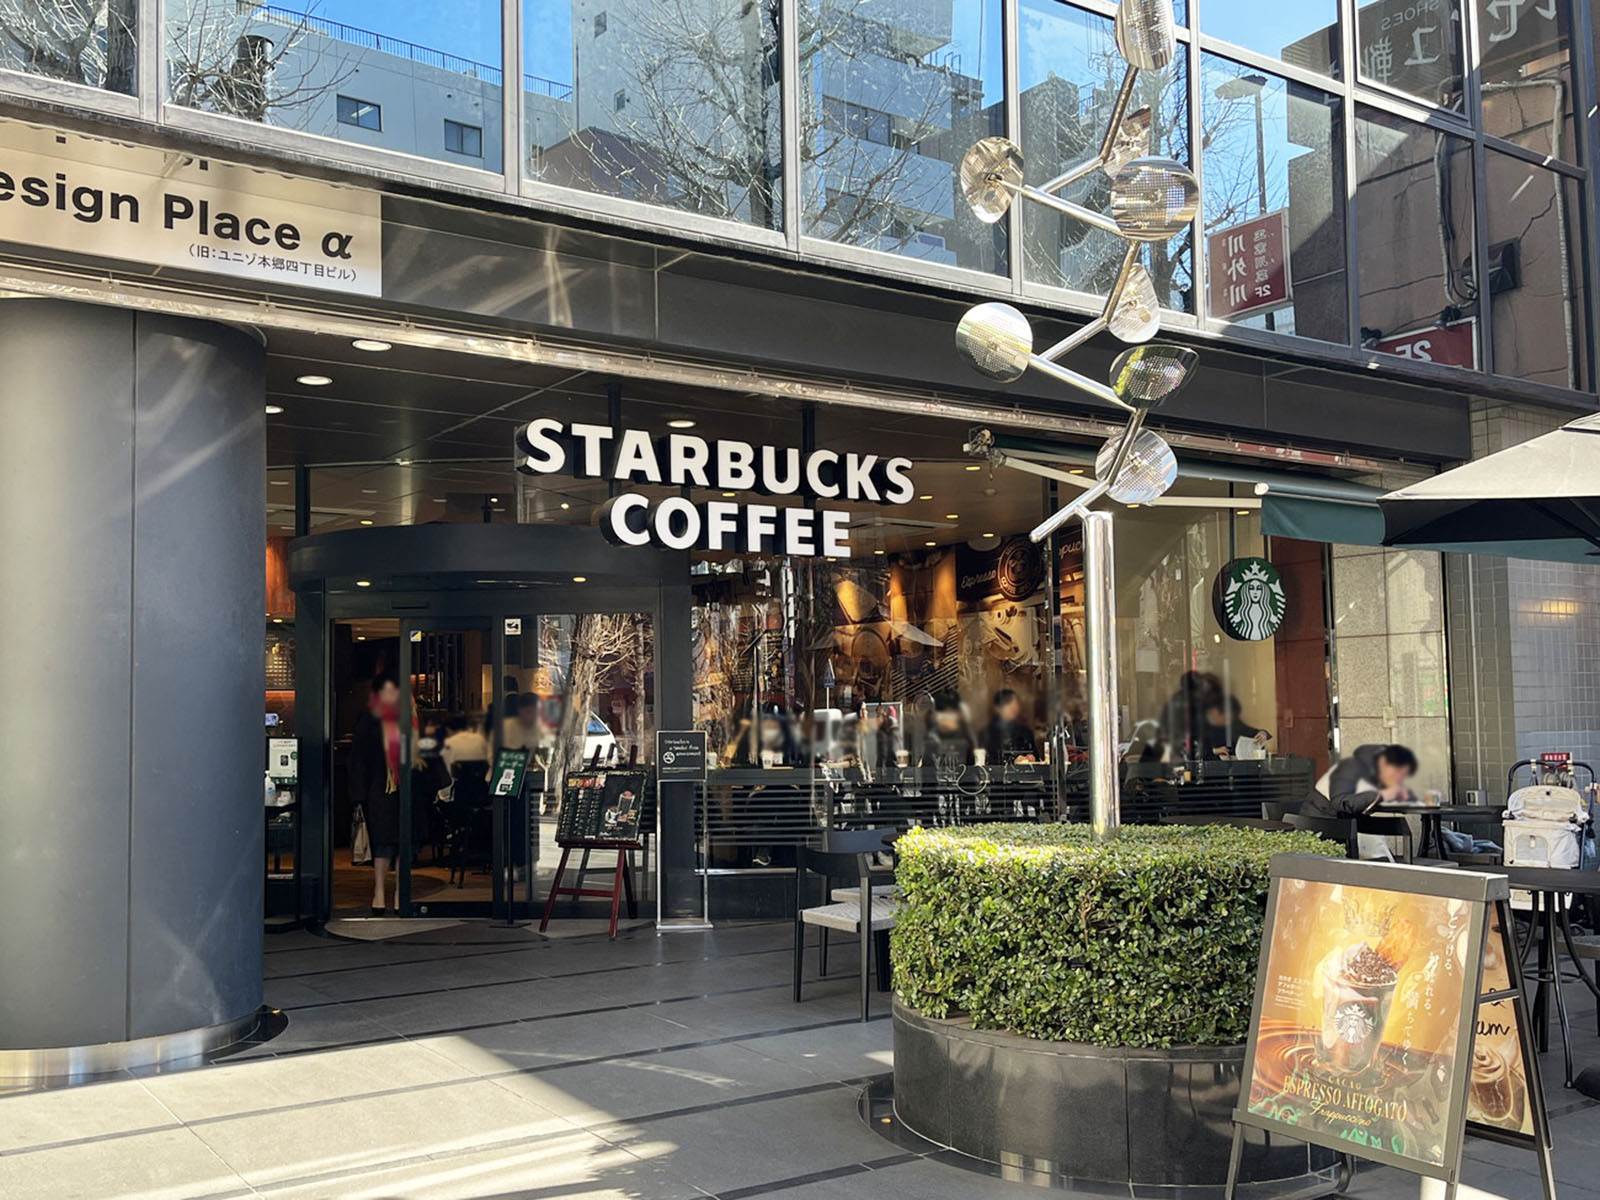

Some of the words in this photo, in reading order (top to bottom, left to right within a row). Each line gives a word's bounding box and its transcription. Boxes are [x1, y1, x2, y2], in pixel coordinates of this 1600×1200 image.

[164, 194, 301, 250] Place
[523, 417, 915, 505] STARBUCKS
[607, 492, 852, 558] COFFEE
[1283, 1074, 1342, 1106] ESPRESSO
[1343, 1091, 1408, 1123] AFFOGATO
